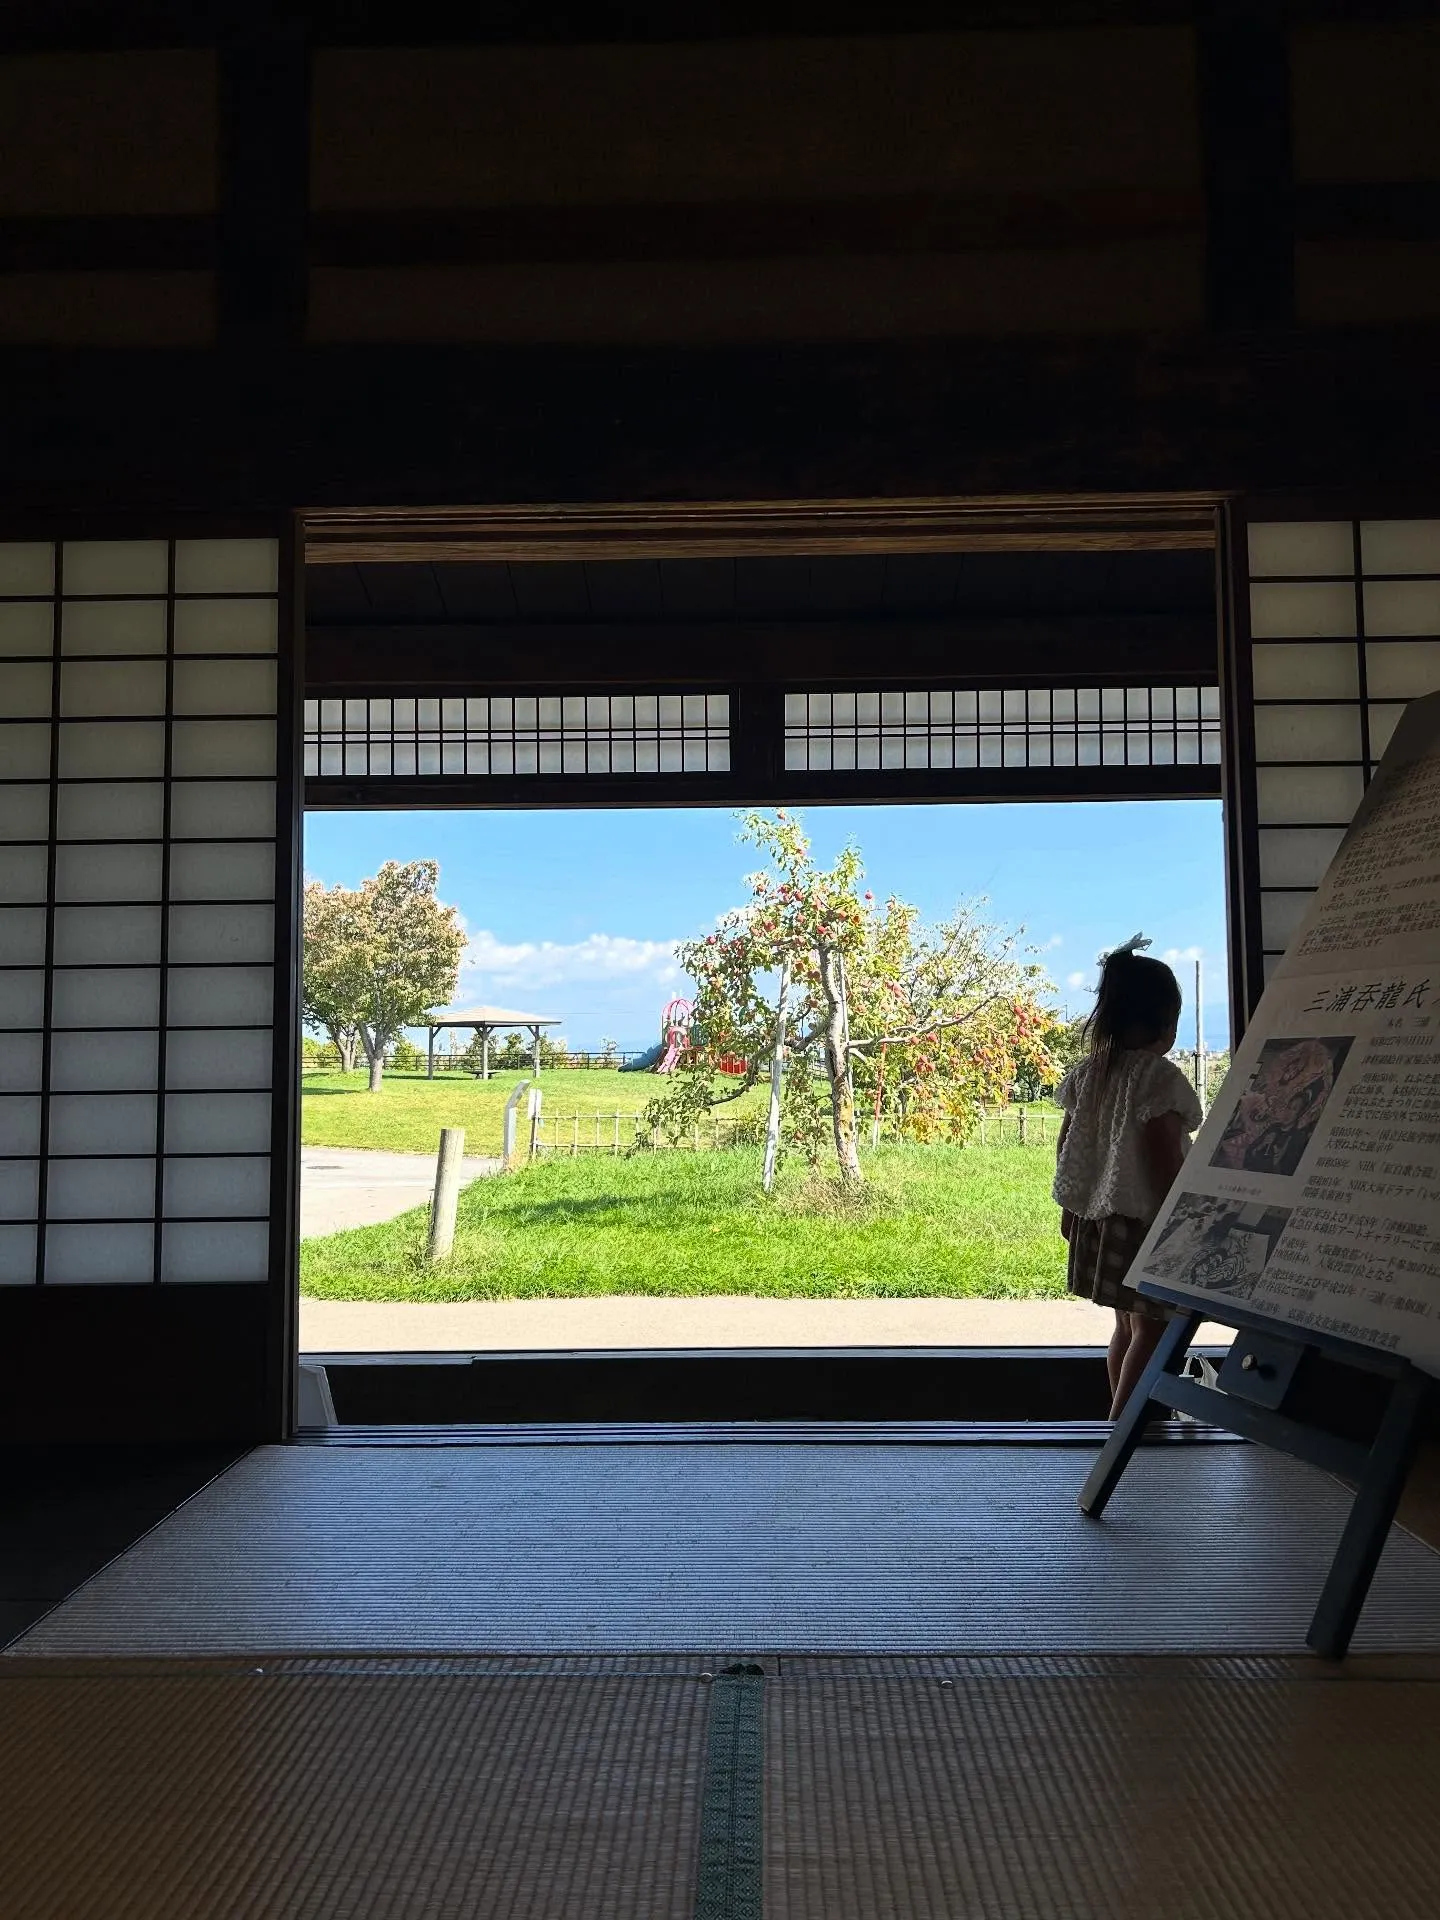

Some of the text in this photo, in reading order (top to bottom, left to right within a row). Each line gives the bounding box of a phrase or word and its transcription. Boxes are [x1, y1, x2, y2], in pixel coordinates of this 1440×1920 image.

[1303, 979, 1430, 1013] 三浦呑龍氏
